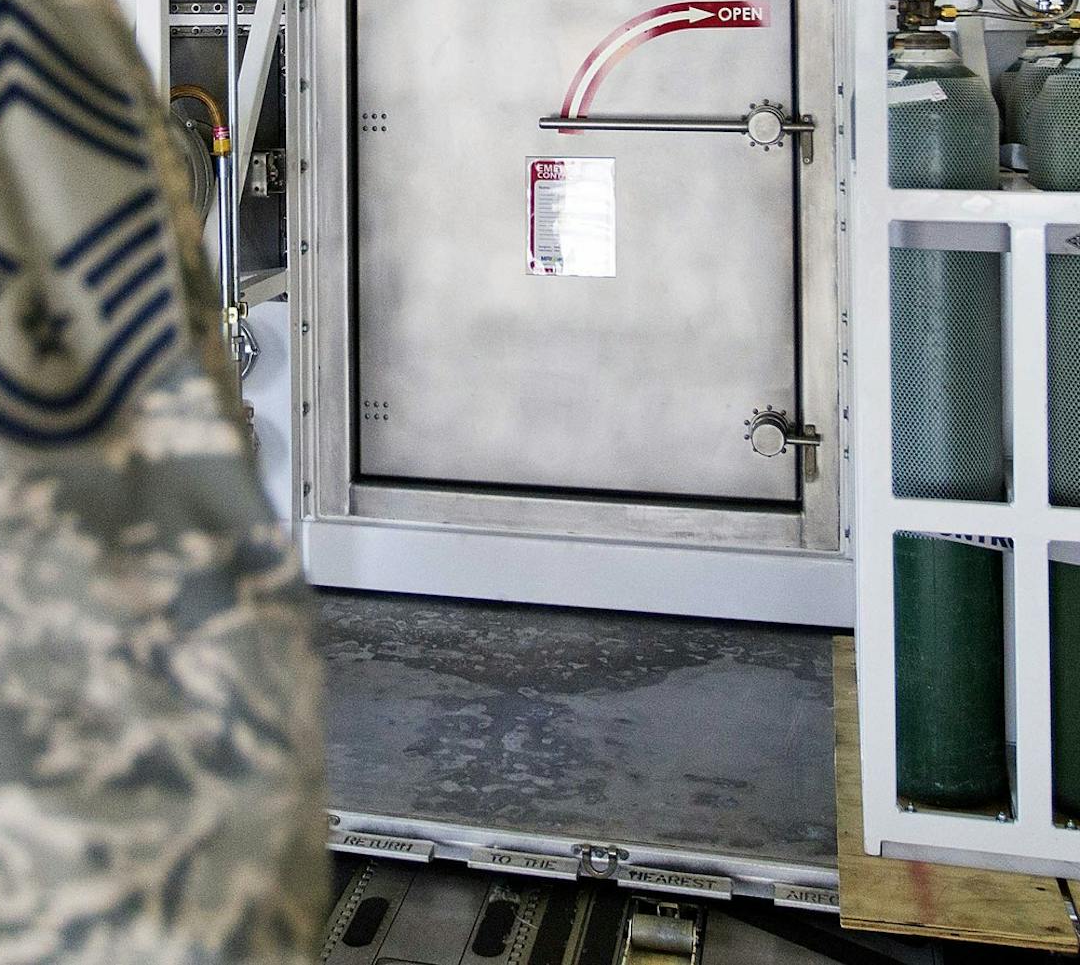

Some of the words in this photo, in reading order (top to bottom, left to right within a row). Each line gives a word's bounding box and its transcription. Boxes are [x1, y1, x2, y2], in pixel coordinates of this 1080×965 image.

[717, 7, 763, 22] OPEN
[343, 835, 414, 852] RETURN
[490, 853, 512, 865] TO
[523, 857, 558, 870] THE
[628, 870, 718, 890] NEAREST
